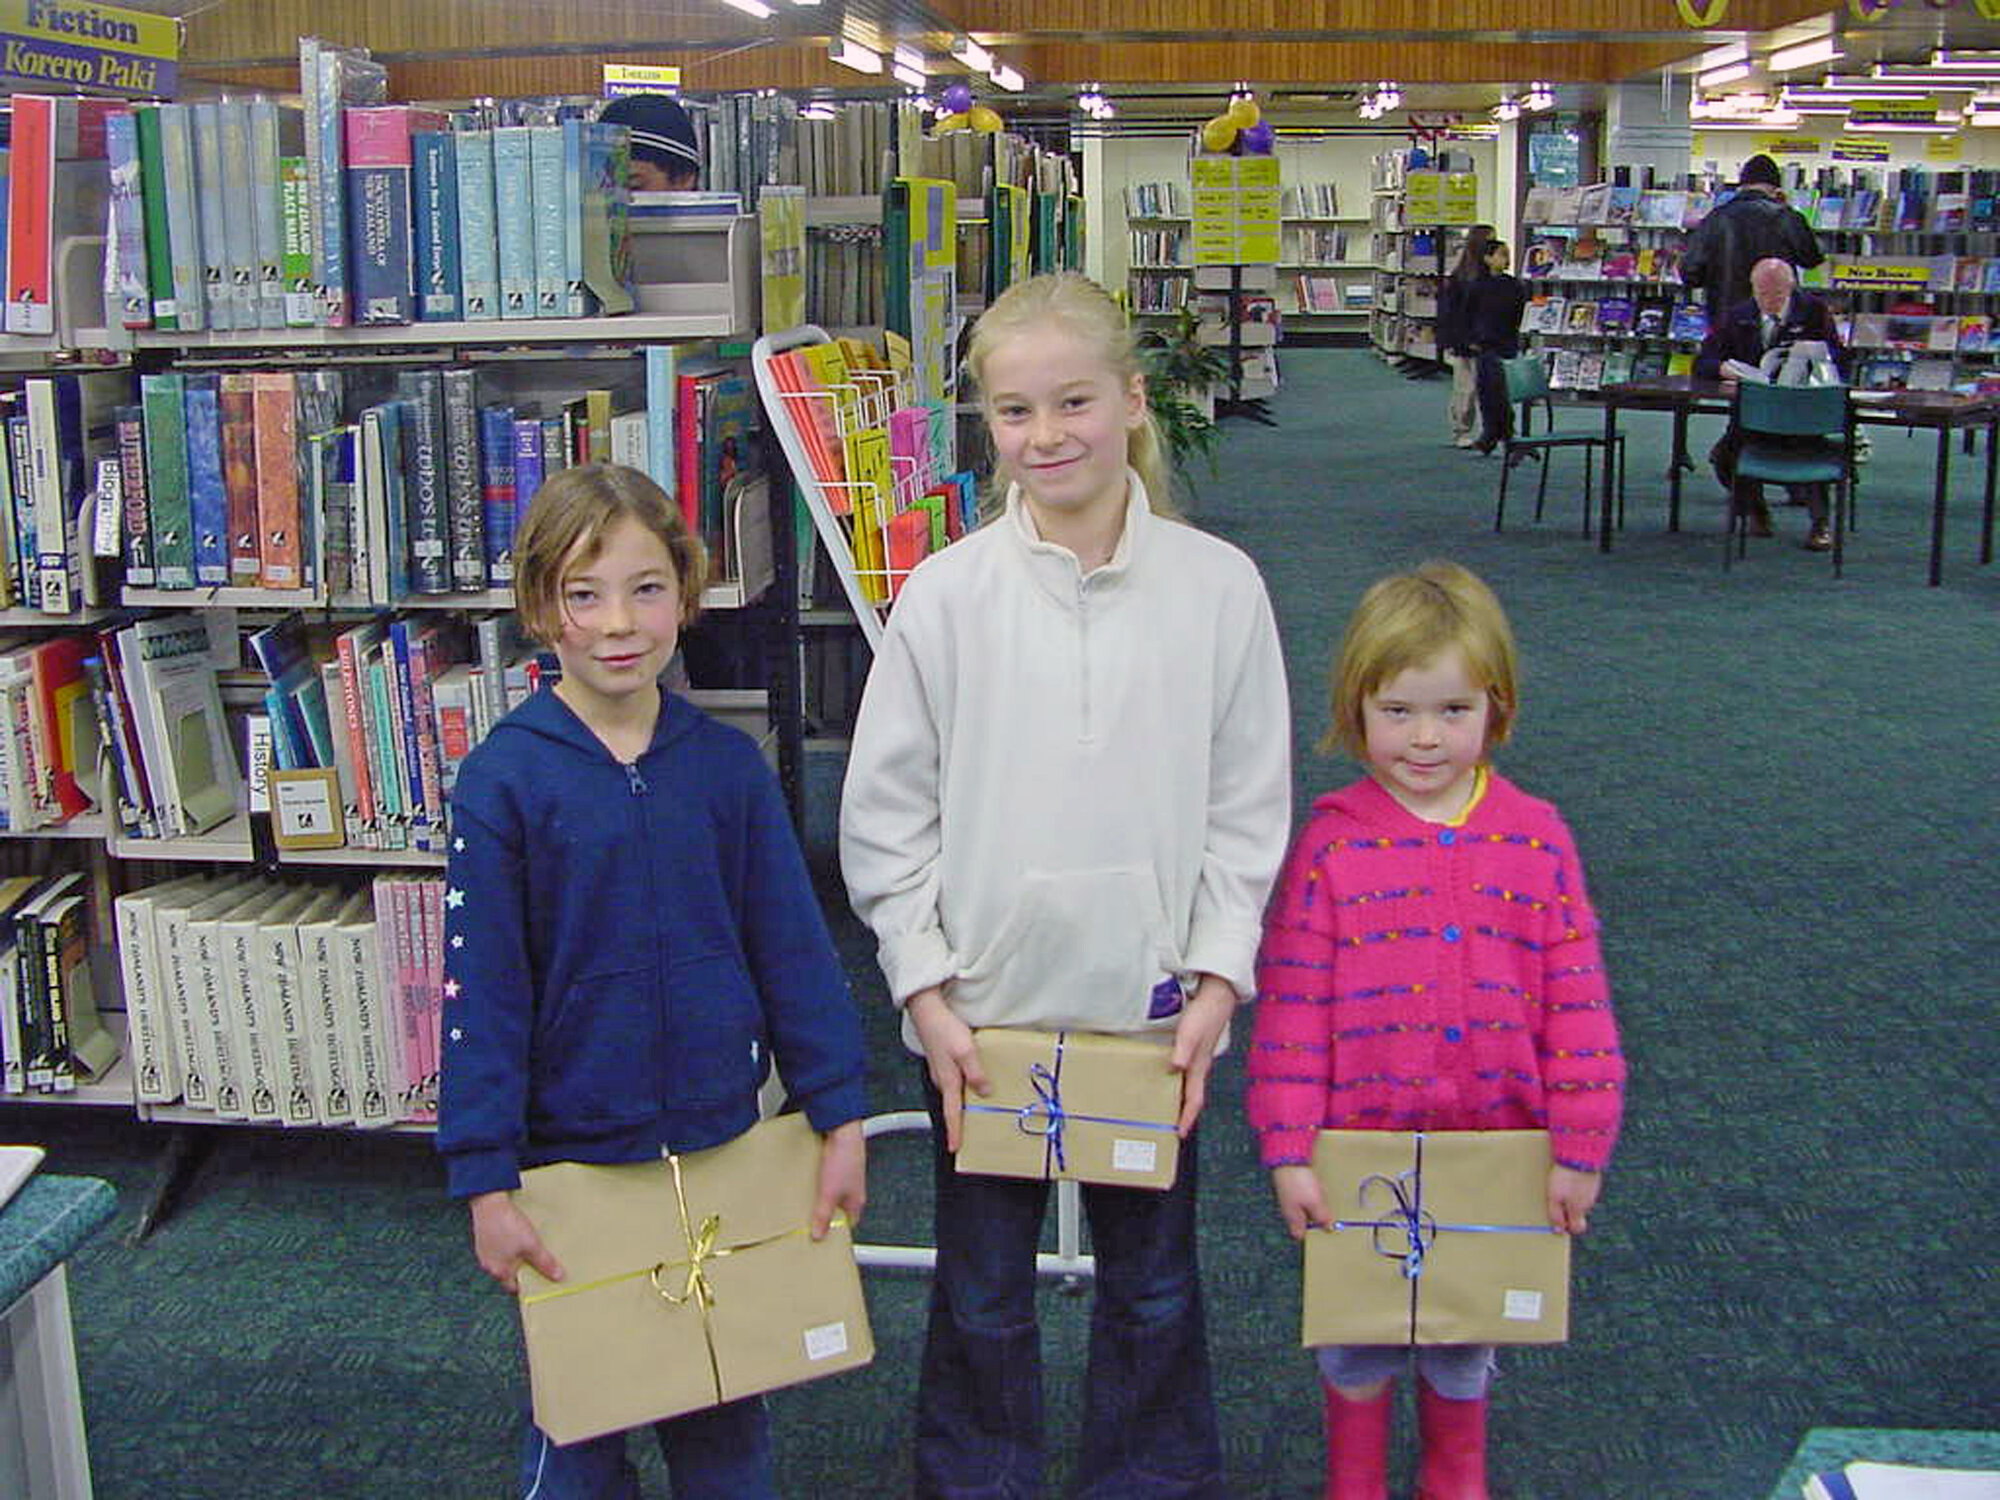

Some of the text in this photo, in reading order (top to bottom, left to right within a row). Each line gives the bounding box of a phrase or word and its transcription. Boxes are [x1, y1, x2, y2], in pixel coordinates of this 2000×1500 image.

[28, 0, 140, 44] Fiction
[4, 40, 157, 91] Korero Paki
[249, 733, 270, 796] History
